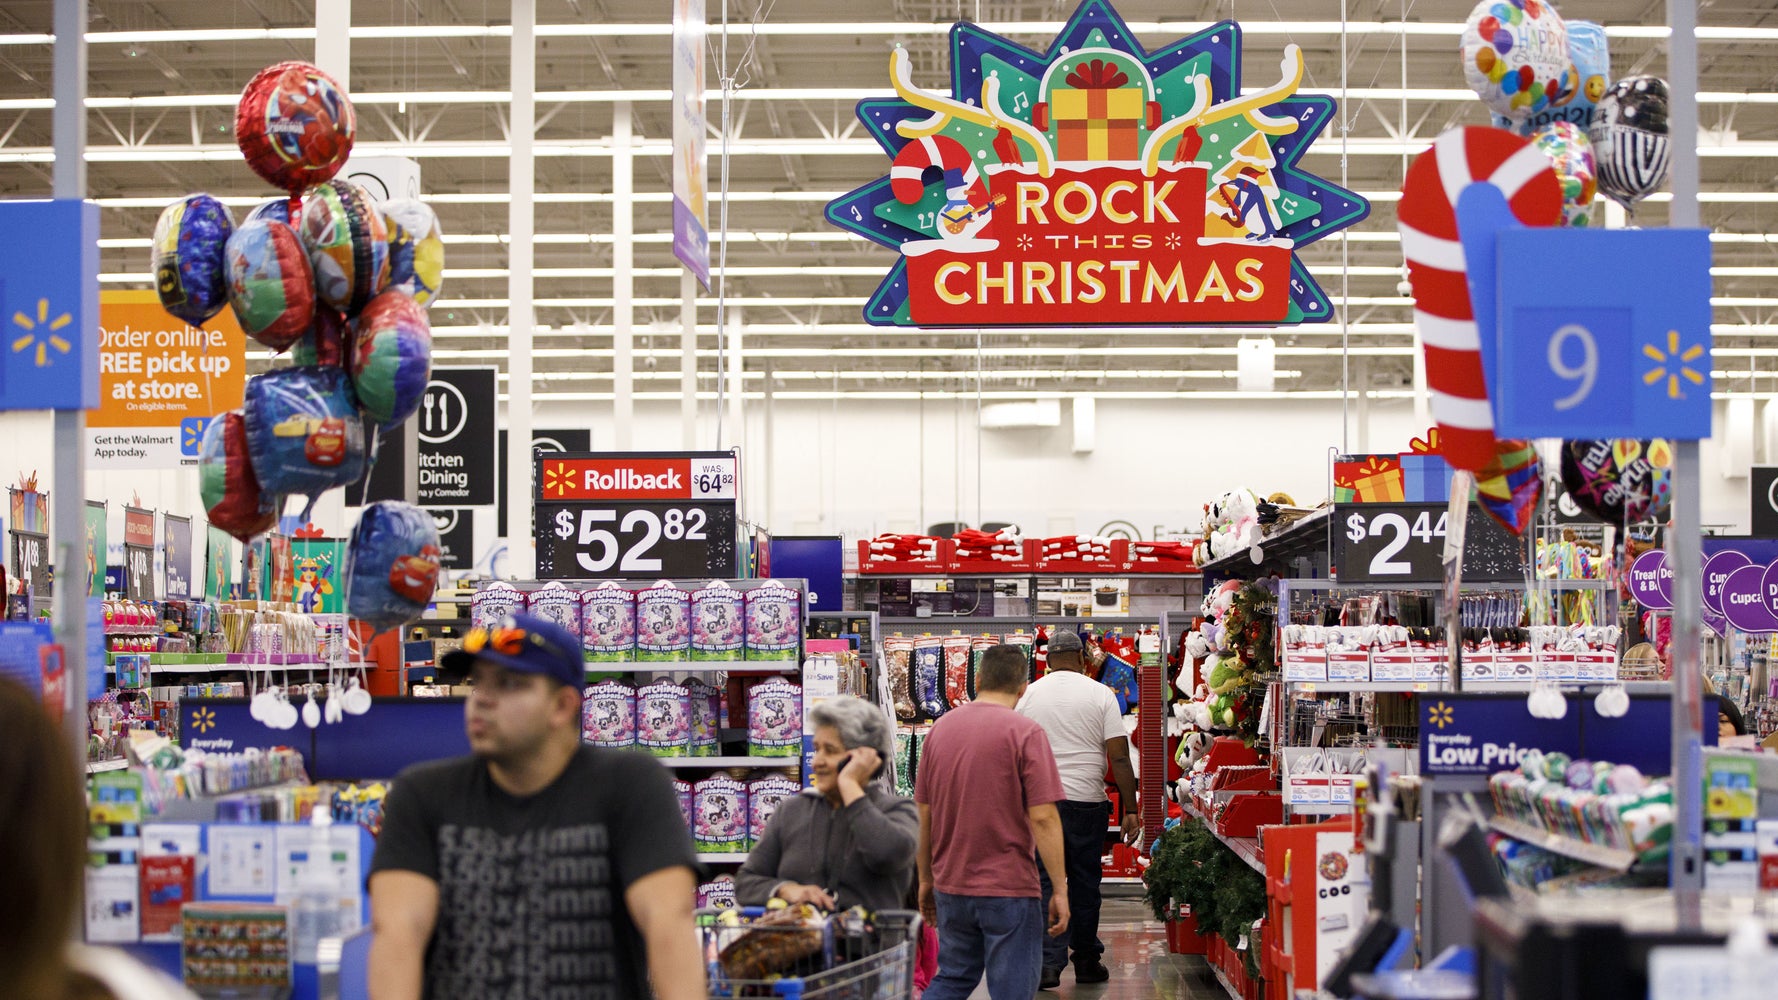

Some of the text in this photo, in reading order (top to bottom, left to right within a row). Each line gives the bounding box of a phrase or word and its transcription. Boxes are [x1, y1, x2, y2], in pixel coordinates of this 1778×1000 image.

[1016, 180, 1180, 225] ROCK
[1045, 234, 1153, 249] THIS
[934, 258, 1265, 305] CHRISTMAS
[155, 325, 227, 347] online.
[147, 351, 196, 378] pick
[200, 356, 230, 378] up
[1547, 323, 1598, 411] 9
[112, 380, 202, 399] at store.
[126, 402, 138, 411] On
[139, 402, 165, 412] eligible
[95, 435, 173, 445] Get the Walmart
[95, 448, 147, 459] App today.
[420, 470, 468, 487] Dining
[584, 465, 724, 490] Rollback WAS:
[428, 490, 434, 498] y
[435, 488, 470, 497] Comedor
[1640, 581, 1647, 591] &
[1709, 586, 1716, 596] &
[191, 738, 234, 750] Everyday
[1428, 733, 1472, 745] Everyday
[1428, 743, 1479, 764] Low
